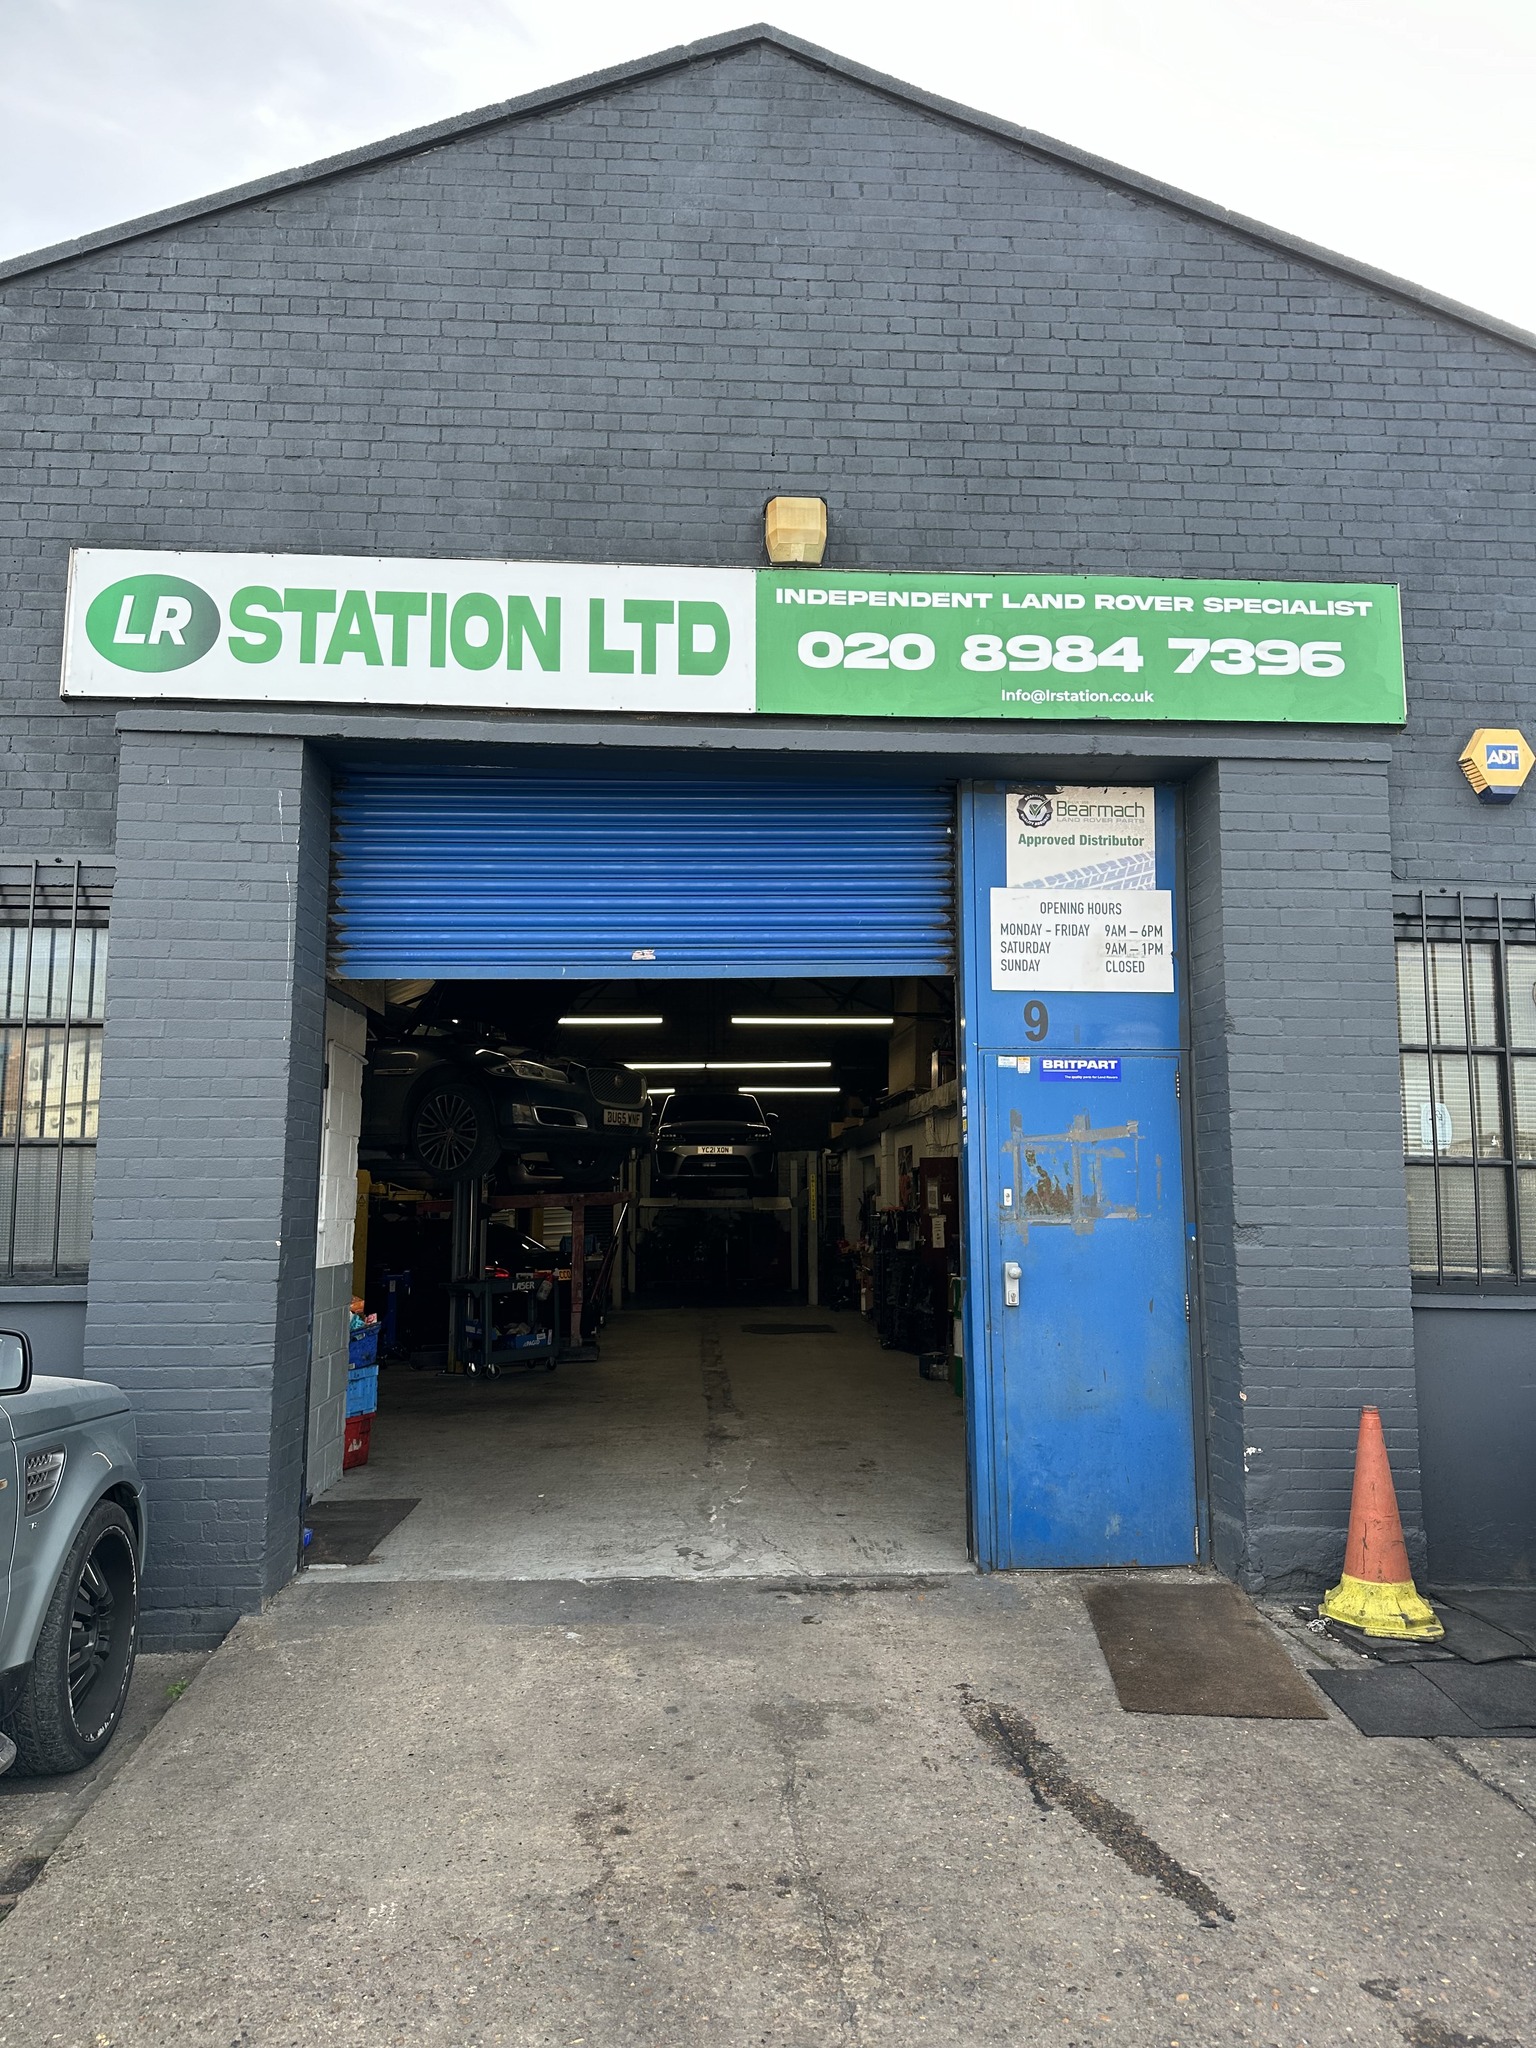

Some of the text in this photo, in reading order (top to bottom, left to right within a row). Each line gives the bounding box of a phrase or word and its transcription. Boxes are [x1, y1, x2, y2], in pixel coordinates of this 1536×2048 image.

[775, 588, 1373, 617] INDEPENDENT LAND ROVER SPECIALIST
[113, 585, 731, 676] LR STATION LTD
[797, 631, 1346, 677] 020 8984 7396
[1487, 749, 1518, 765] ADT
[1057, 801, 1144, 817] Bearmach
[1018, 834, 1144, 847] Approved Distributor
[1040, 902, 1122, 915] OPENING HOURS
[1001, 923, 1042, 936] MONDAY
[1055, 924, 1090, 936] FRIDAY
[1105, 925, 1126, 937] 9AM
[1141, 925, 1163, 937] 6PM
[1001, 941, 1051, 954] SATURDAY
[1105, 943, 1127, 955] 9AM
[1142, 943, 1163, 955] 1PM
[1001, 959, 1145, 973] SUNDAY CLOSED
[1023, 1000, 1049, 1042] 9
[1042, 1060, 1118, 1069] BRITPART
[512, 1281, 535, 1290] LASER
